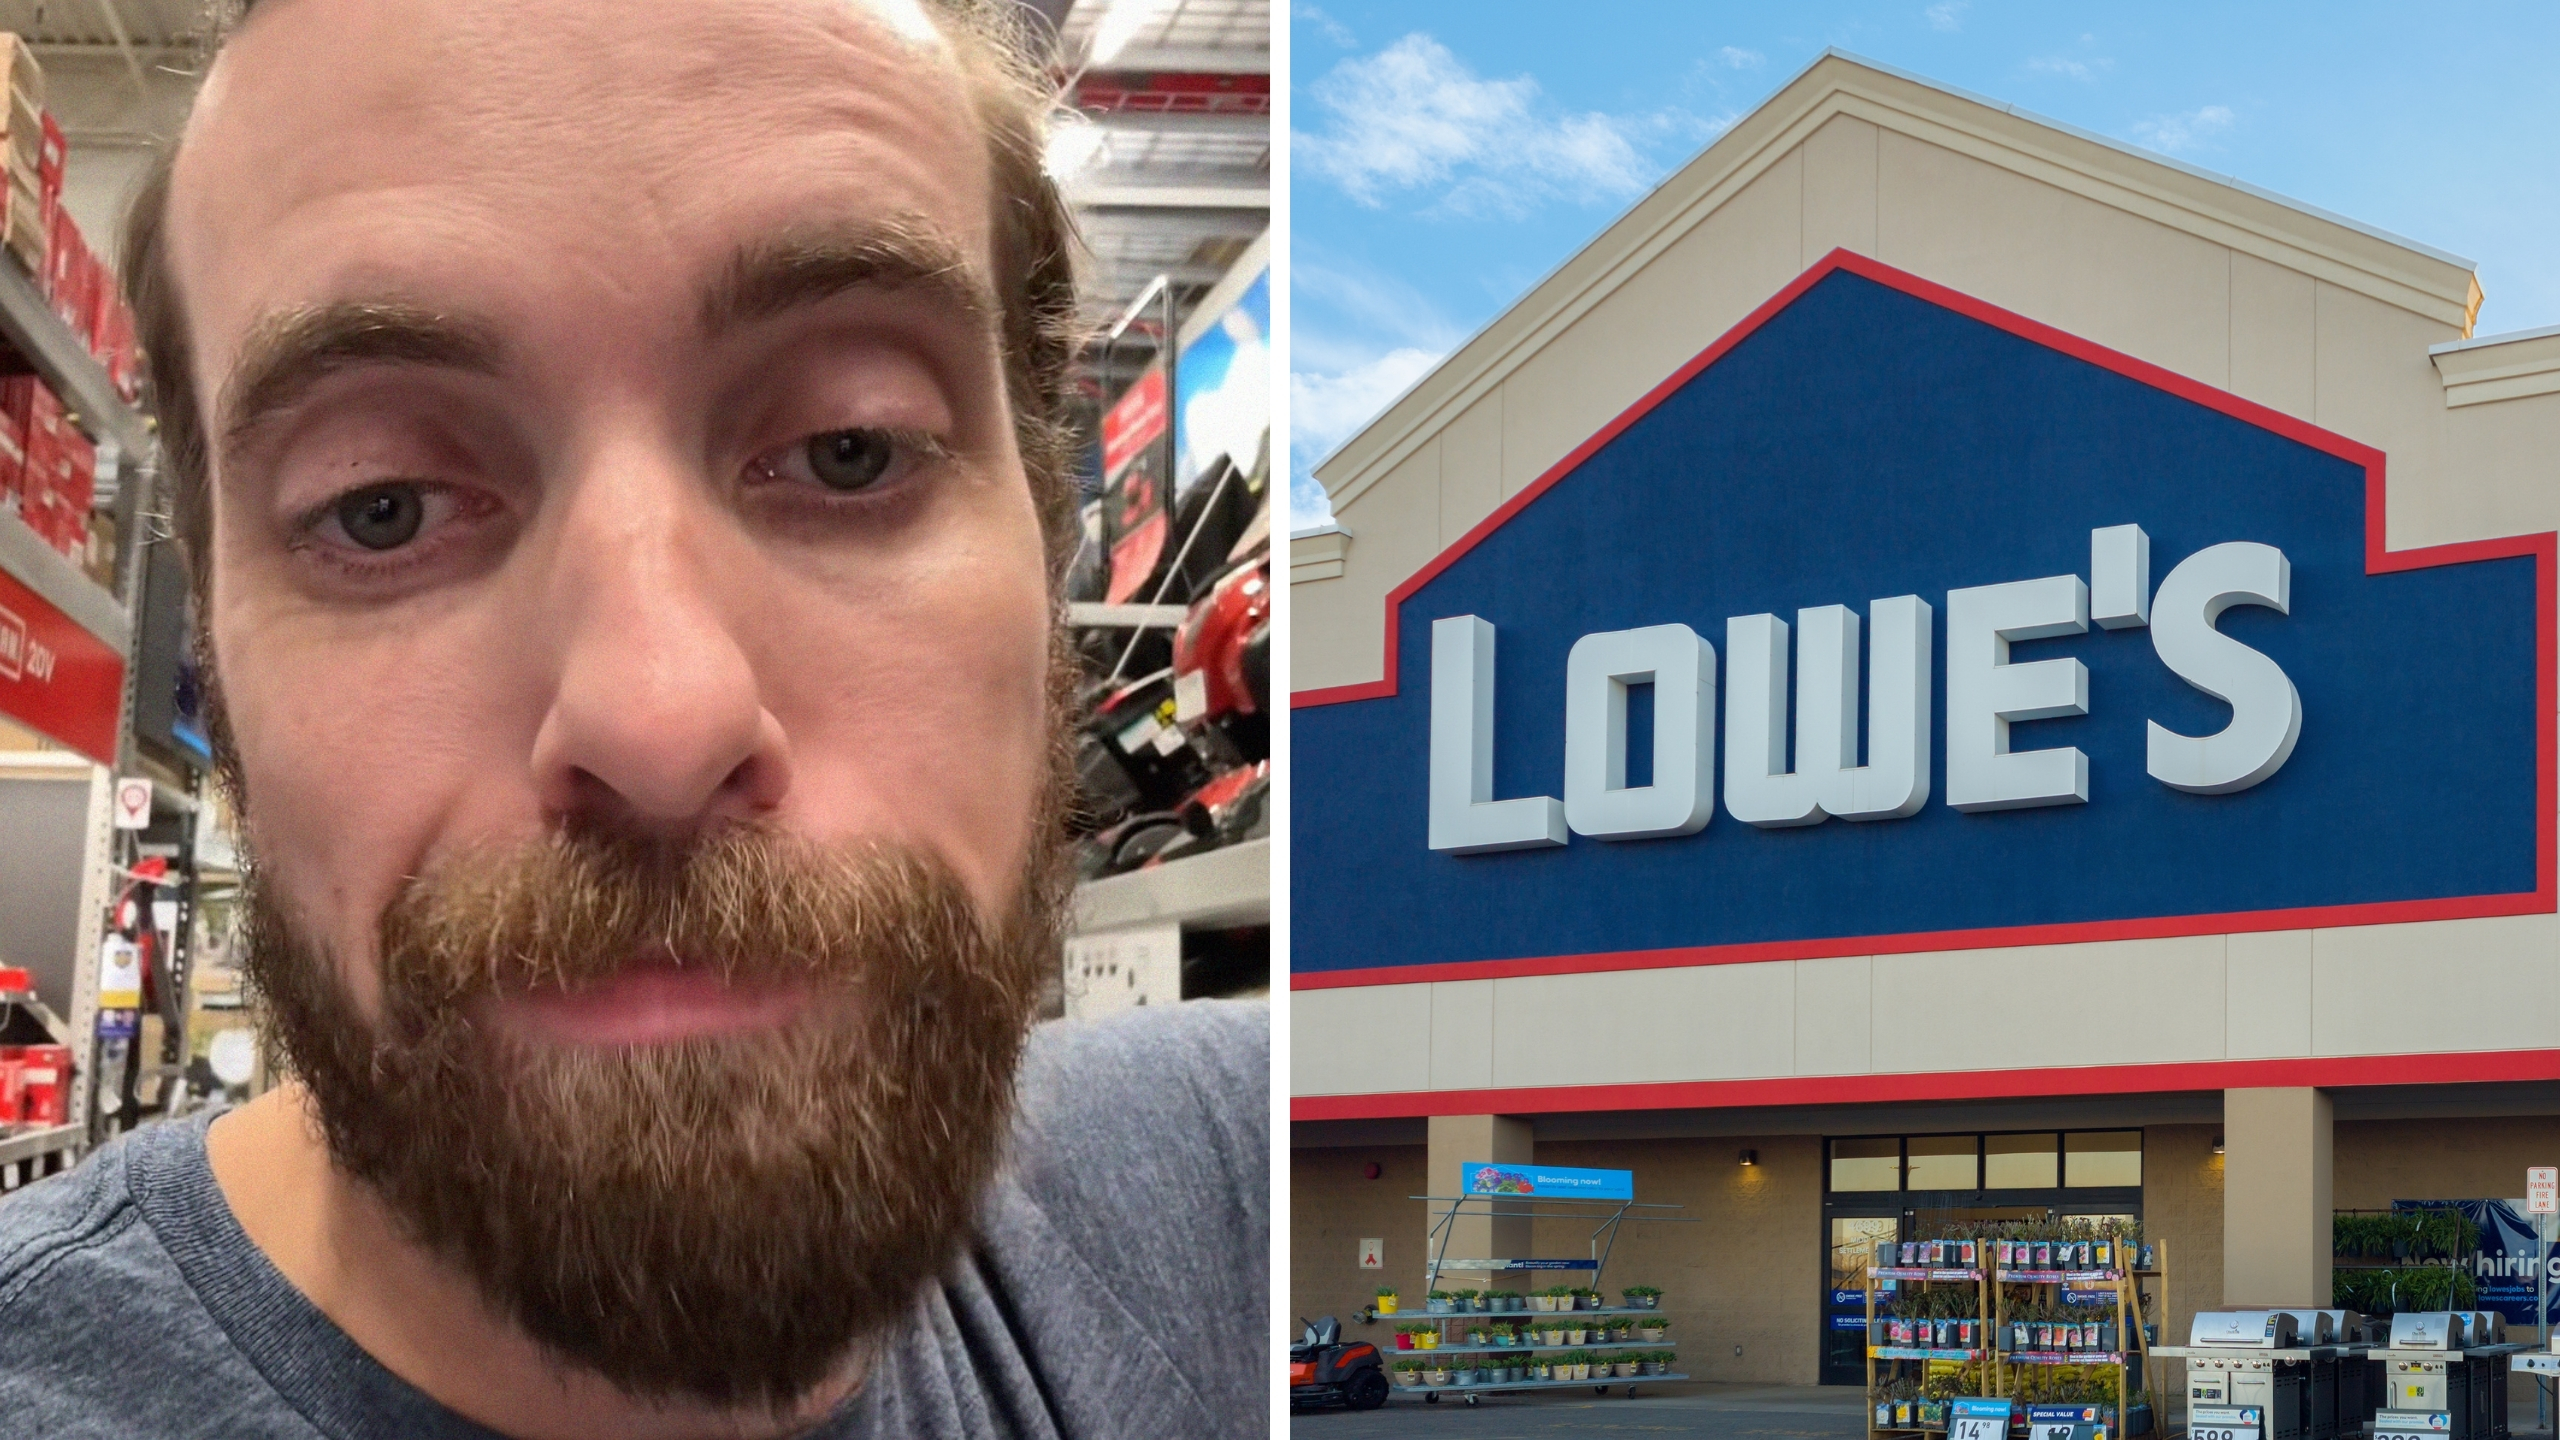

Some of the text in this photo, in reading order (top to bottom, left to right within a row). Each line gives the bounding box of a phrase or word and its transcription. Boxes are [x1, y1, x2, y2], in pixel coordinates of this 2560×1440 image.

[26, 638, 56, 684] 20V
[1428, 523, 2302, 855] LOWE'S
[1537, 1175, 1602, 1186] Blooming now!
[2538, 1172, 2547, 1180] NO
[2535, 1191, 2549, 1199] FIRE
[2534, 1201, 2550, 1209] LANE
[2476, 1249, 2560, 1284] hiring
[2489, 1285, 2525, 1294] lowesjobs
[2478, 1294, 2539, 1302] lowescareers.co
[1971, 1405, 1993, 1413] Blooming
[1959, 1420, 1991, 1440] 14 98
